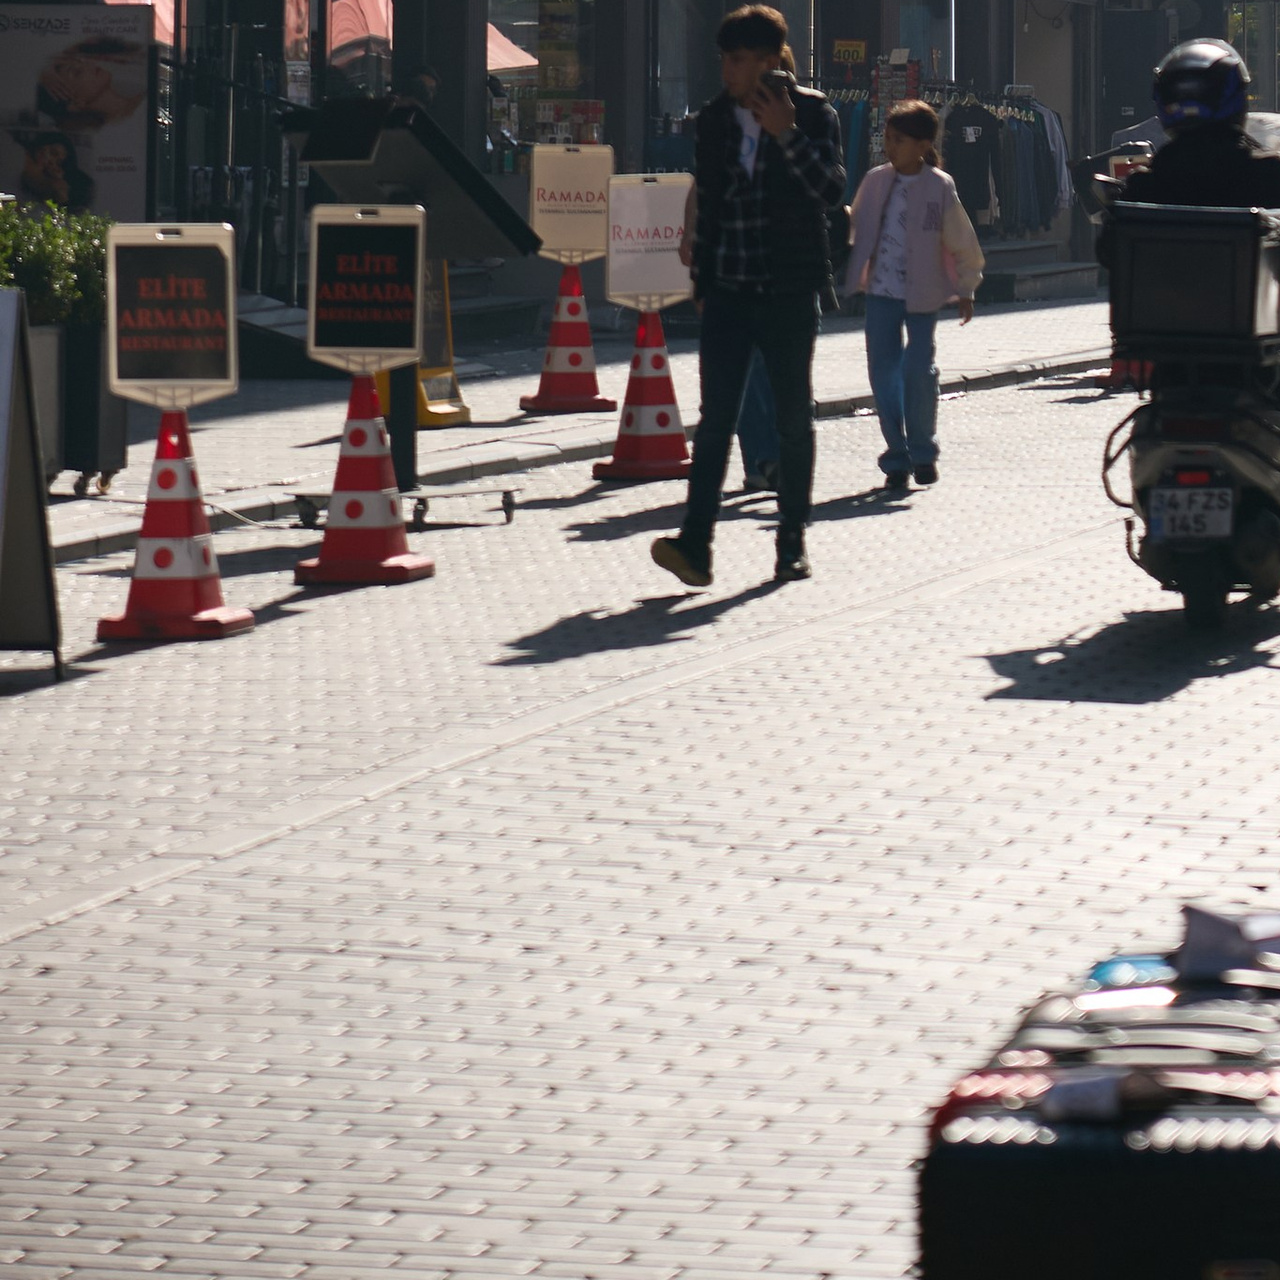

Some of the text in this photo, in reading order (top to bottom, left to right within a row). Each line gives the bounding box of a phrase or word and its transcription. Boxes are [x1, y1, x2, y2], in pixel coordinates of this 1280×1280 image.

[536, 187, 607, 203] RAMADA
[612, 224, 685, 241] RAMADA
[336, 251, 398, 275] ELİTE
[138, 274, 207, 300] ELİTE
[318, 282, 414, 302] ARMADA
[120, 308, 227, 330] ARMADA
[318, 307, 414, 321] RESTAURANT
[120, 335, 226, 351] RESTAURANT
[1188, 491, 1231, 509] FZS
